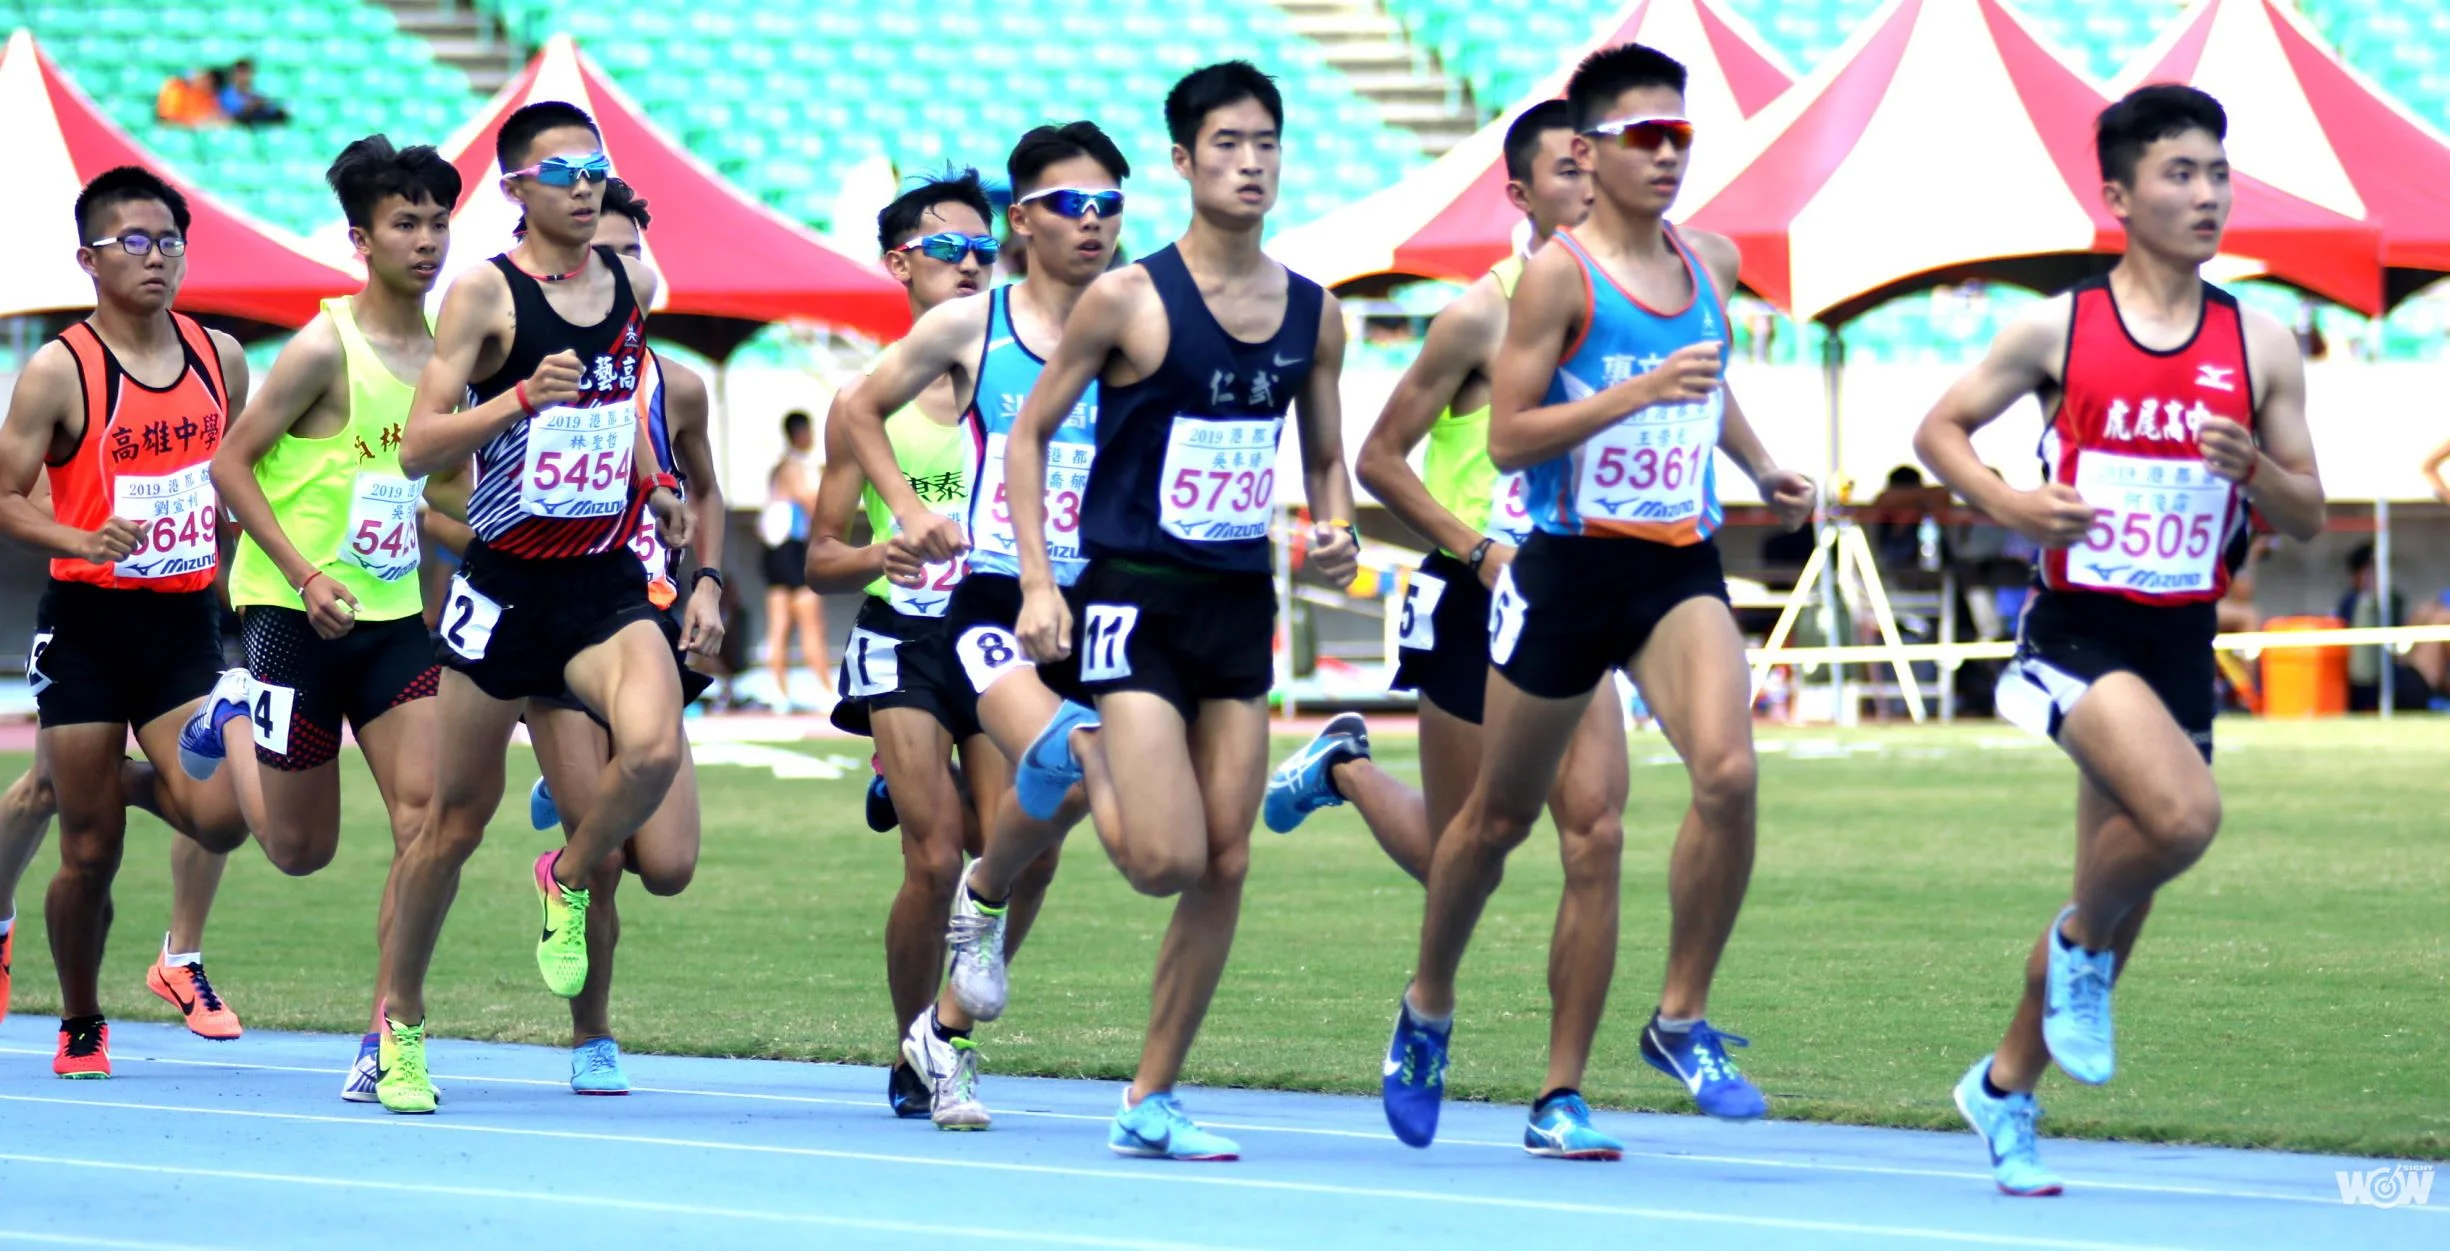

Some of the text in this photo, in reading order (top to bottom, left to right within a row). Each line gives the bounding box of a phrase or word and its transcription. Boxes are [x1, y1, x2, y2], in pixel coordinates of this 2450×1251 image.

[111, 412, 220, 464] 高雄中學
[547, 414, 581, 429] 2019
[1189, 427, 1224, 445] 2019
[129, 483, 161, 496] 2019
[534, 446, 630, 493] 5454
[1170, 468, 1275, 513] 5730
[1594, 443, 1701, 491] 5361
[371, 484, 403, 498] 2019
[2085, 507, 2214, 559] 5505
[447, 594, 474, 649] 2
[1087, 614, 1123, 670] 11
[976, 632, 1015, 669] 8
[254, 689, 274, 739] 4
